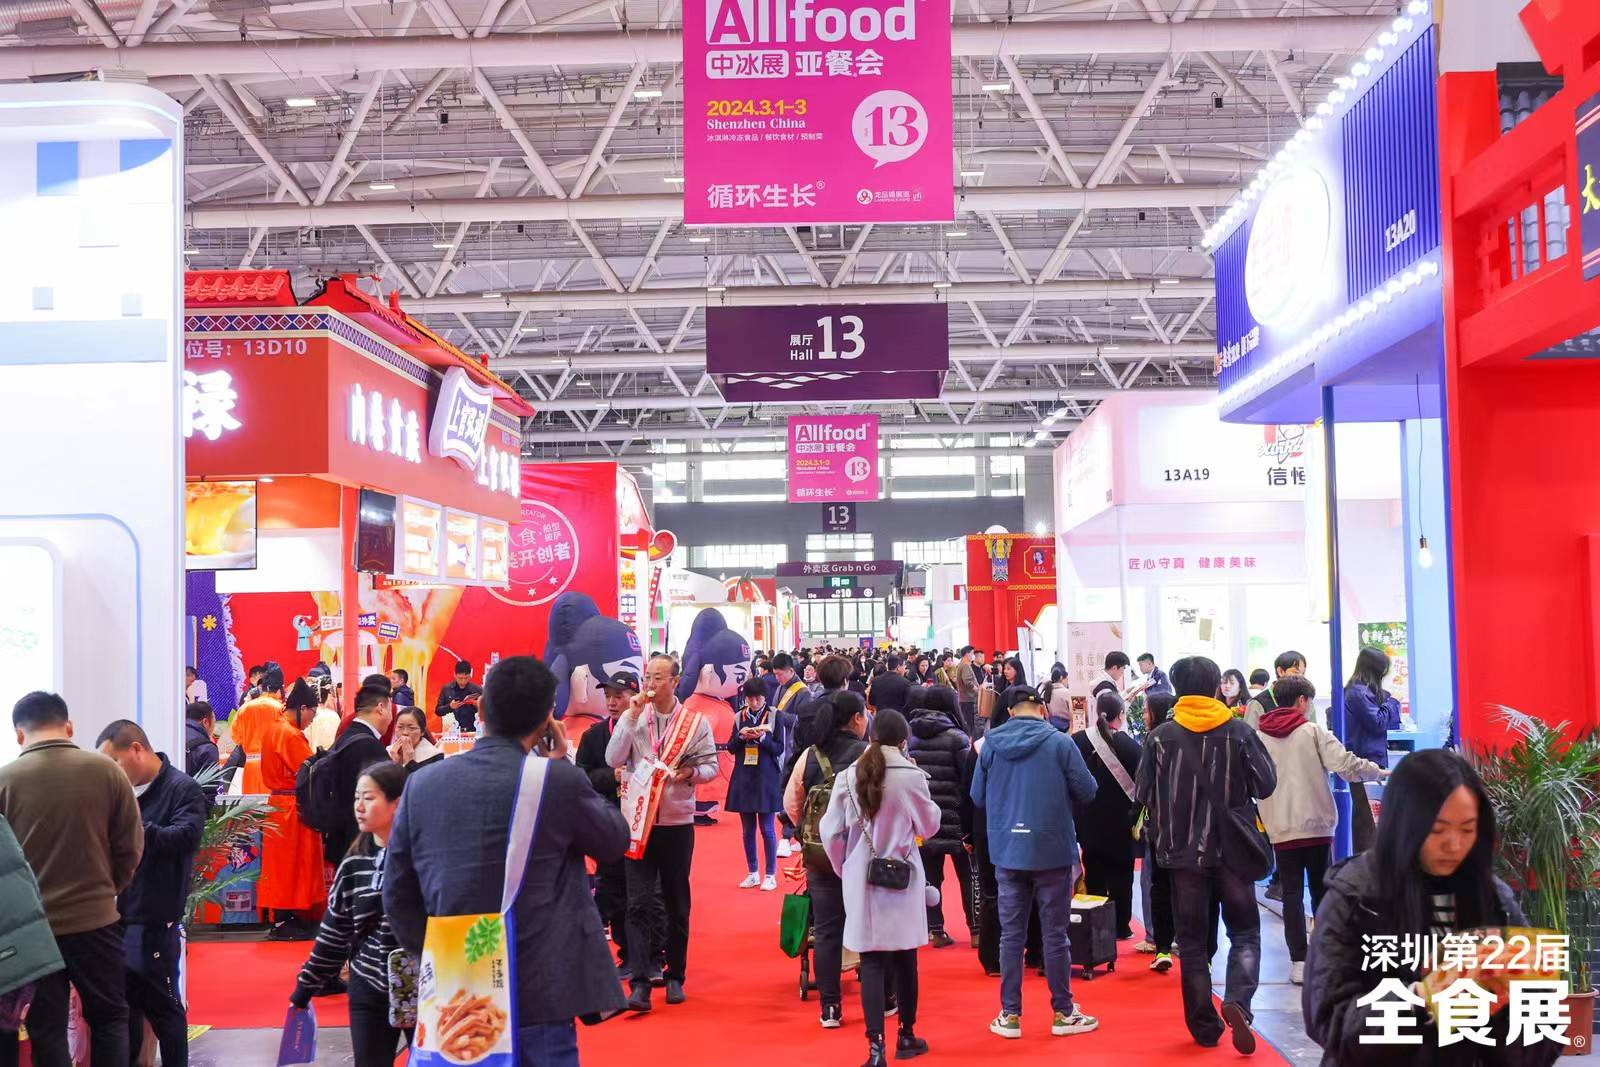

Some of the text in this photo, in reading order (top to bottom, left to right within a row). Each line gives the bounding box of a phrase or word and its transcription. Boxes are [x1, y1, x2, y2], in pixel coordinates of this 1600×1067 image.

[706, 0, 916, 45] Allfood
[708, 48, 884, 77] 中冰展 亚餐会
[706, 118, 806, 130] Shenzhen China
[864, 105, 920, 147] 13
[706, 183, 816, 209] 循环生长
[1385, 209, 1416, 253] 13A20
[789, 334, 814, 346] 展厅
[816, 314, 867, 360] 13
[243, 338, 308, 356] 13D10
[790, 349, 814, 361] Hall
[795, 423, 867, 441] Allfood
[851, 461, 868, 476] 13
[1164, 468, 1210, 482] 13A19
[828, 505, 850, 525] 13
[803, 564, 830, 574] 外卖区
[831, 563, 854, 572] Grab
[863, 563, 877, 572] Go
[1128, 556, 1257, 570] 匠心守真 健康美味
